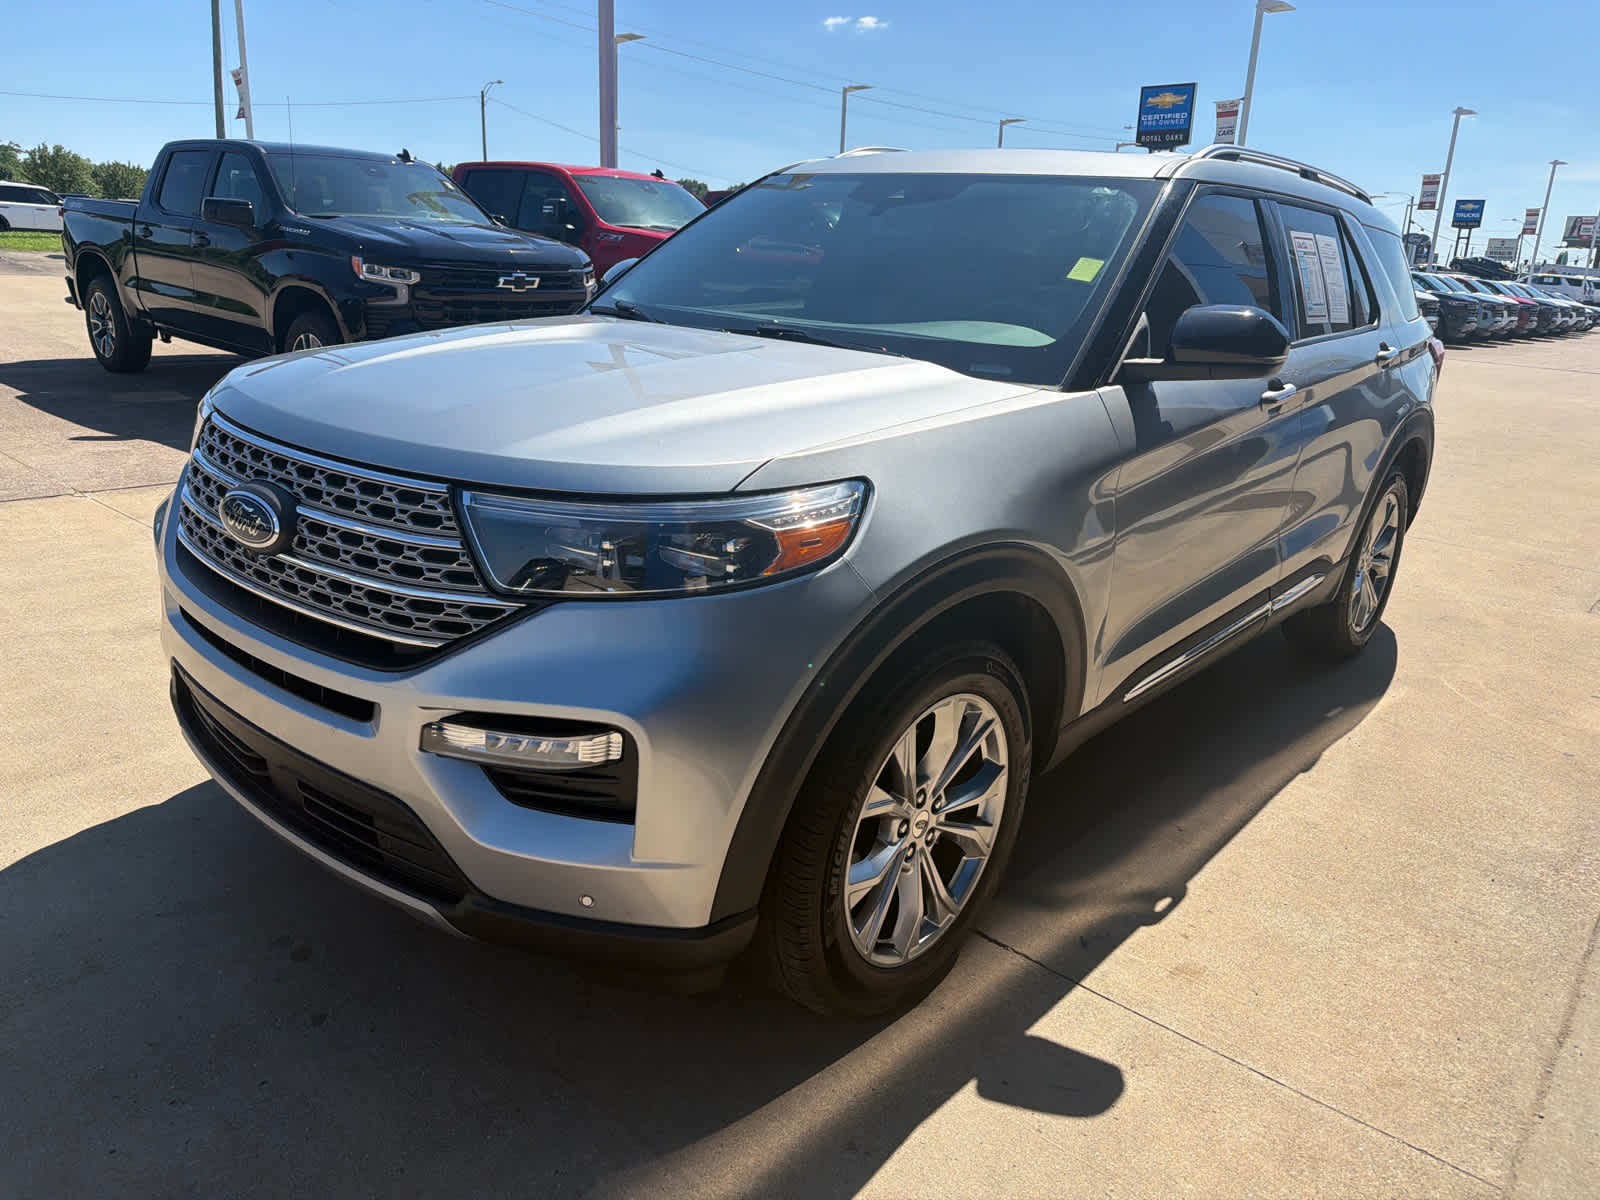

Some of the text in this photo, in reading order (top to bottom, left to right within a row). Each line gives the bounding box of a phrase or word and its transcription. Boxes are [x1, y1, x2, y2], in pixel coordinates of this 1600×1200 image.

[1141, 112, 1188, 121] CERTIFIED
[1141, 134, 1162, 142] ROYAL
[227, 500, 268, 537] Ford
